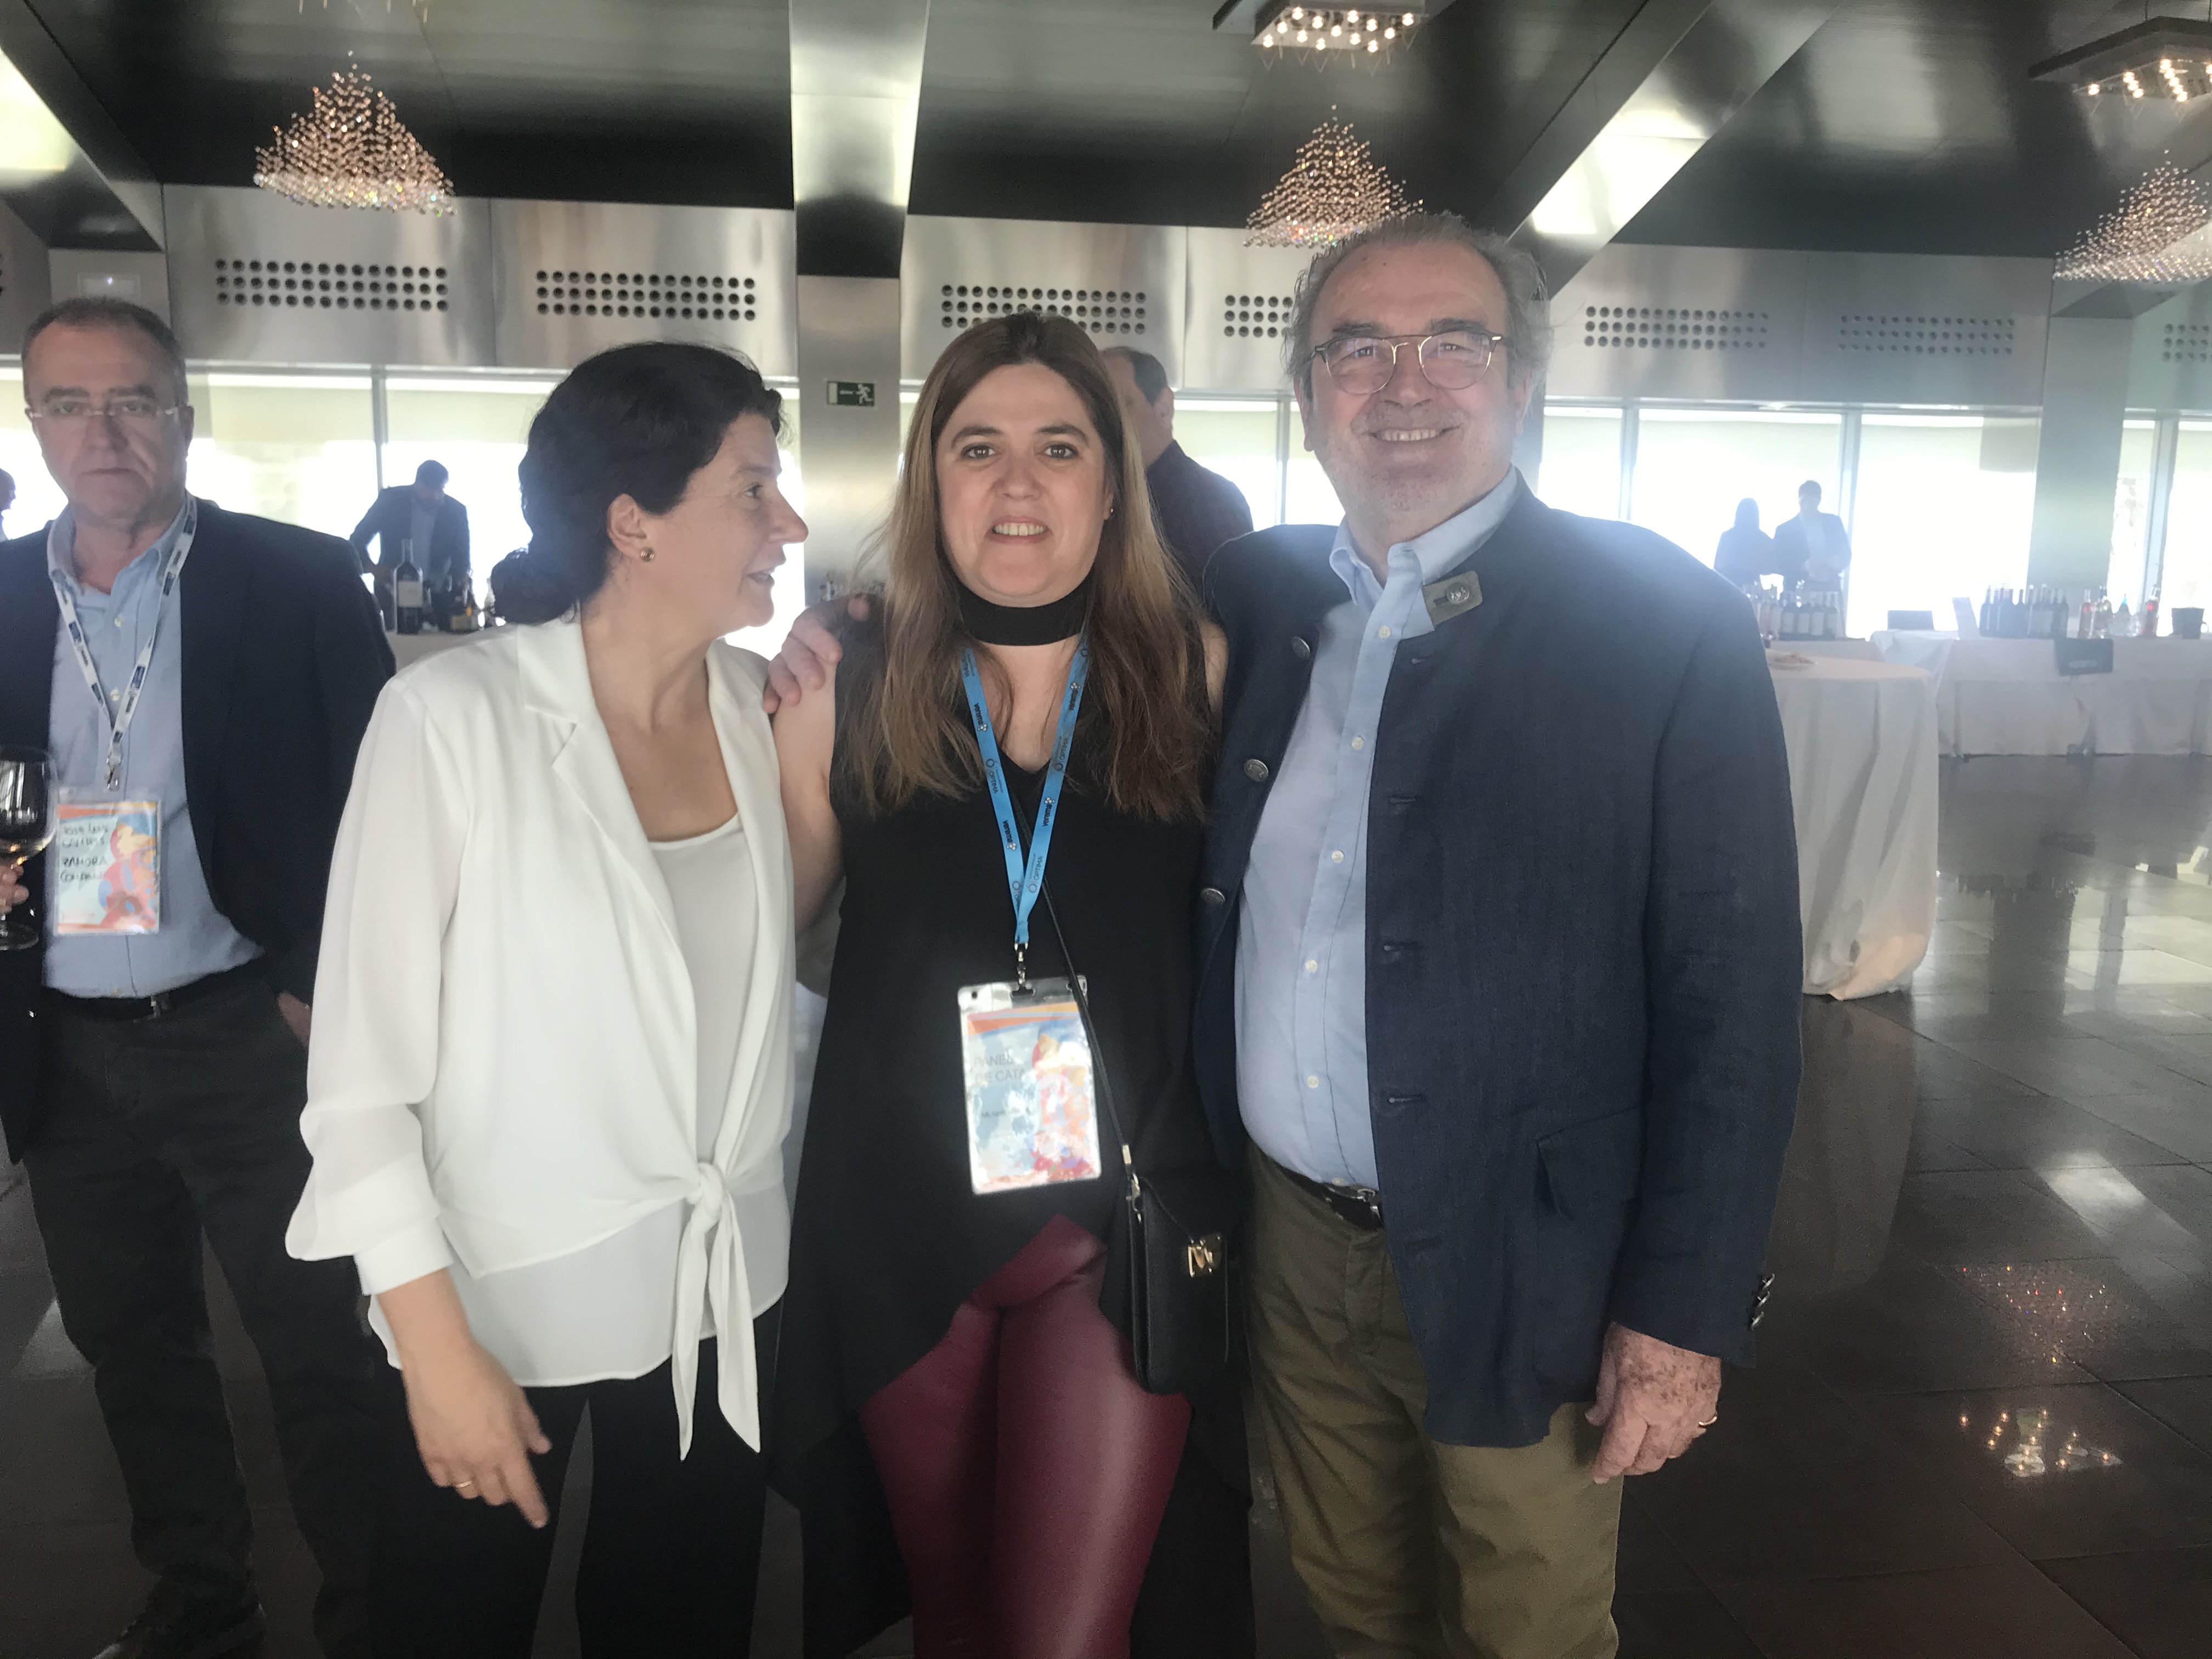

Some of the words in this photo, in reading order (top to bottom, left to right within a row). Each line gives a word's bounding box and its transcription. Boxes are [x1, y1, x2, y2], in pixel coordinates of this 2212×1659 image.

[974, 702, 984, 725] verema
[989, 771, 998, 794] OPTIMA
[1042, 804, 1052, 827] verema
[1003, 820, 1013, 844] verema
[1033, 856, 1043, 881] OPTIMA
